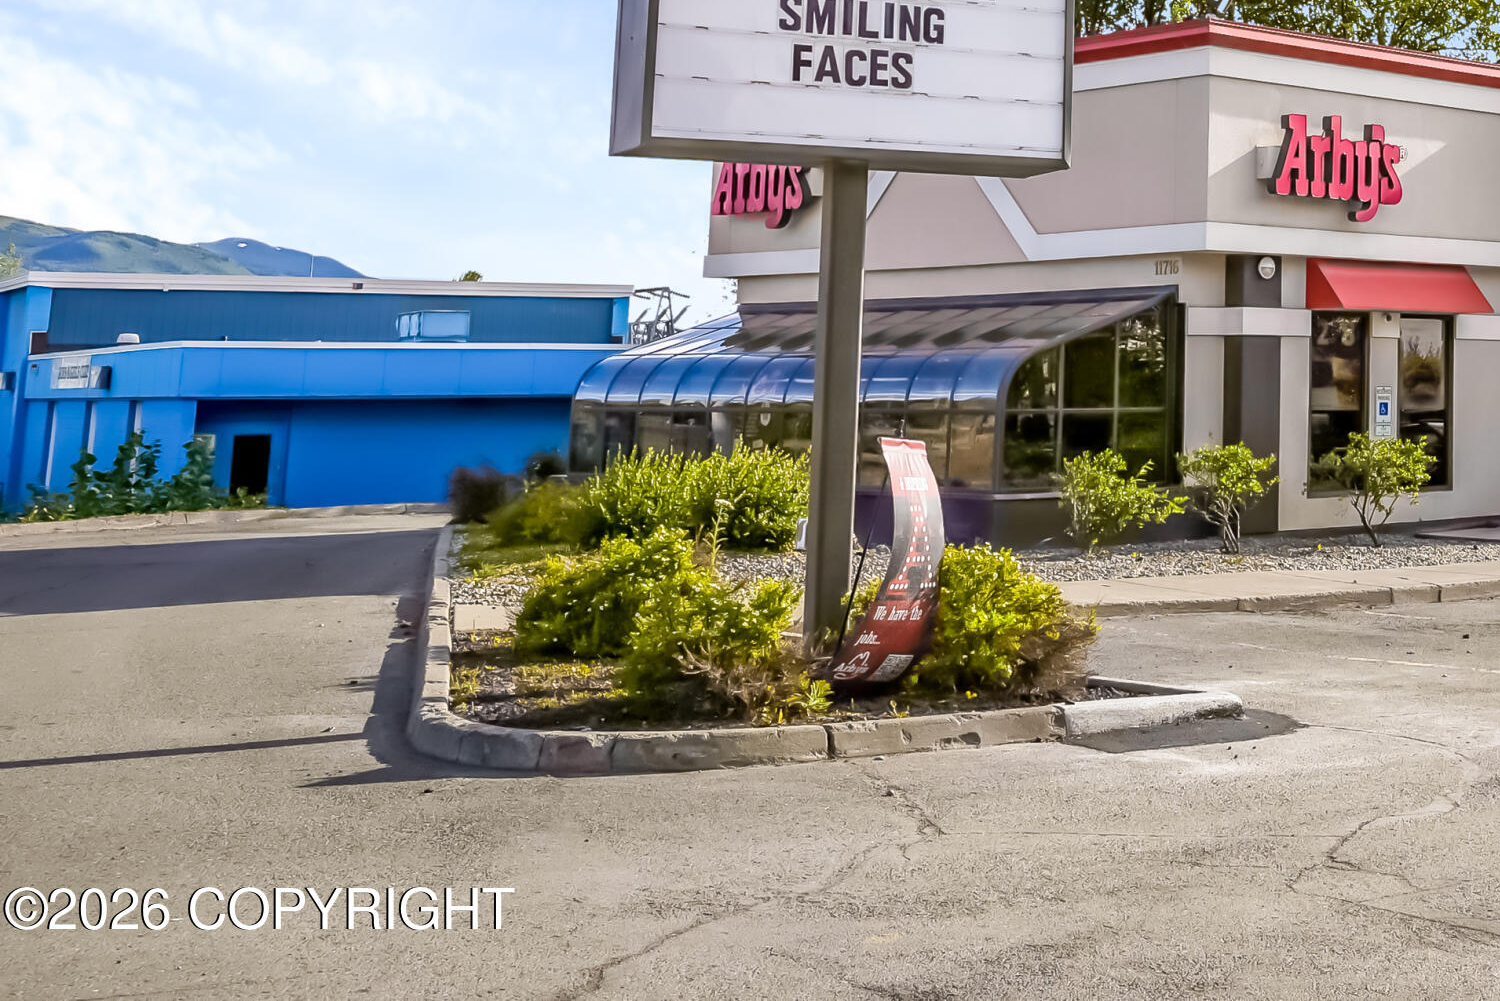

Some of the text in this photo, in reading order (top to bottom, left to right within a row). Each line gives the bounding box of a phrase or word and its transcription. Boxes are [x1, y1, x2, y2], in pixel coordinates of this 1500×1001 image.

[792, 44, 914, 89] FACES
[1275, 113, 1403, 223] Arby's
[873, 606, 923, 621] We have the
